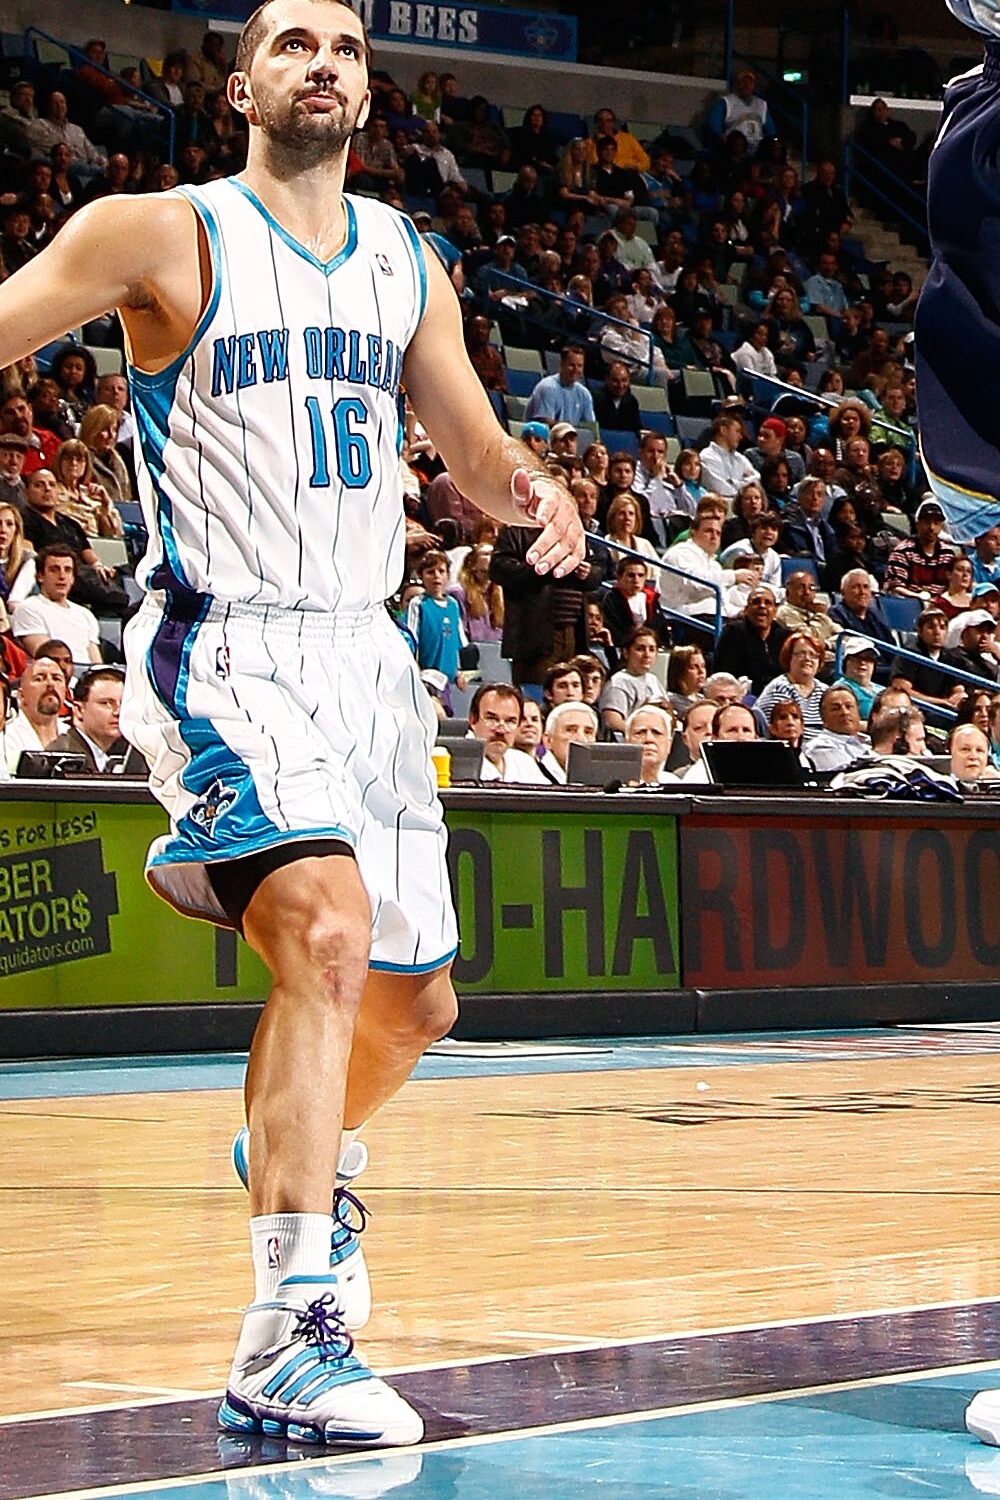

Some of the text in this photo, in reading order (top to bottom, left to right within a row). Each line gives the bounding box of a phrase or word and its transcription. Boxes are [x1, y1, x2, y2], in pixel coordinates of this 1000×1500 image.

[389, 0, 479, 45] BEES
[212, 328, 290, 398] NEW
[305, 396, 372, 489] 16
[15, 823, 48, 846] FOR
[54, 811, 97, 839] LESS!
